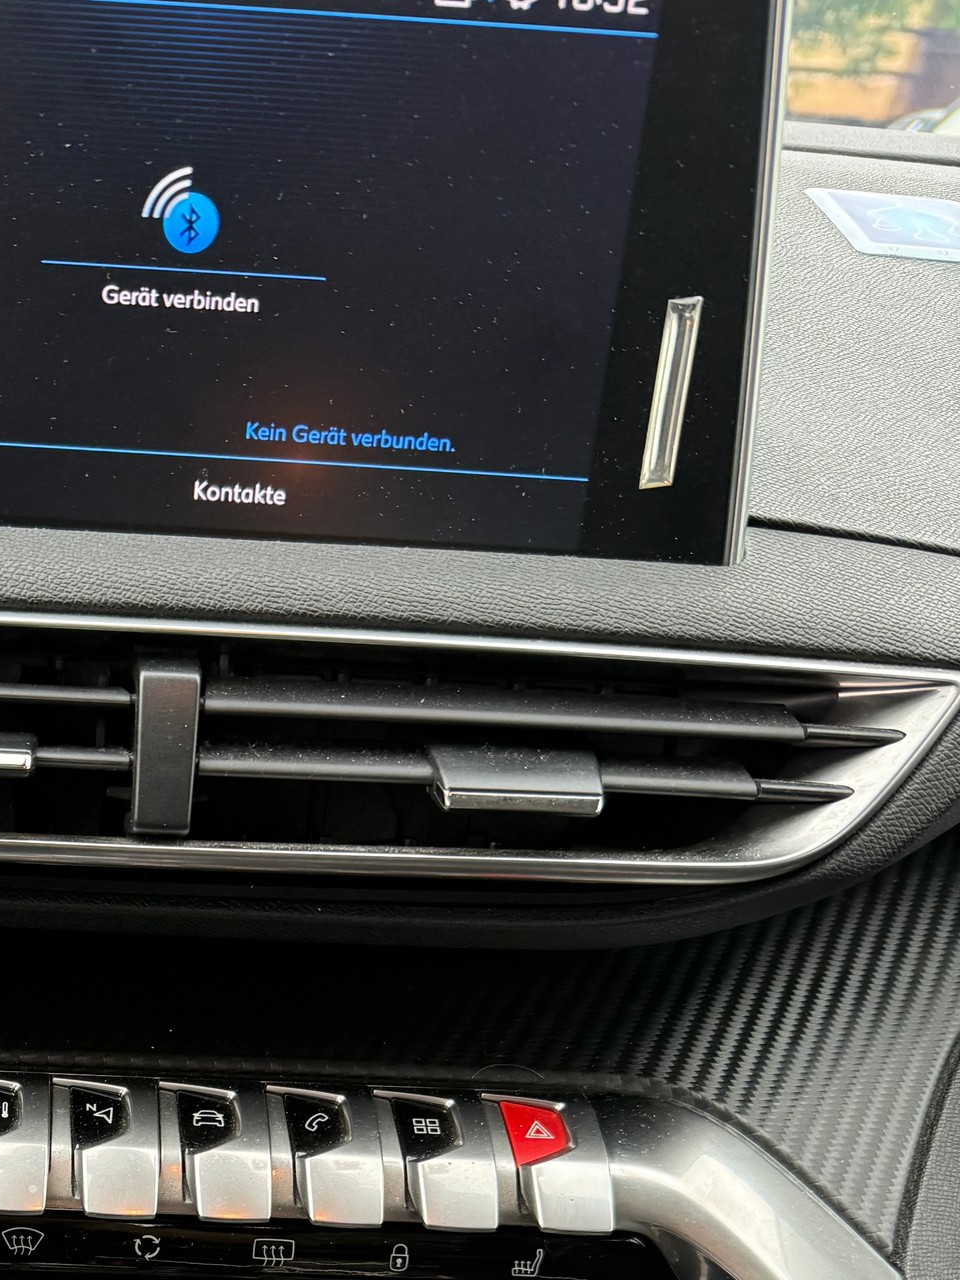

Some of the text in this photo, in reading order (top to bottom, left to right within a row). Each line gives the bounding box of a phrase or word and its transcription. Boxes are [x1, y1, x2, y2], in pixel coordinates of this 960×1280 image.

[102, 285, 259, 313] Gerät verbinden
[245, 421, 456, 452] Kein Gerät verbunden.
[193, 480, 287, 505] Kontakte
[86, 1103, 96, 1111] N
